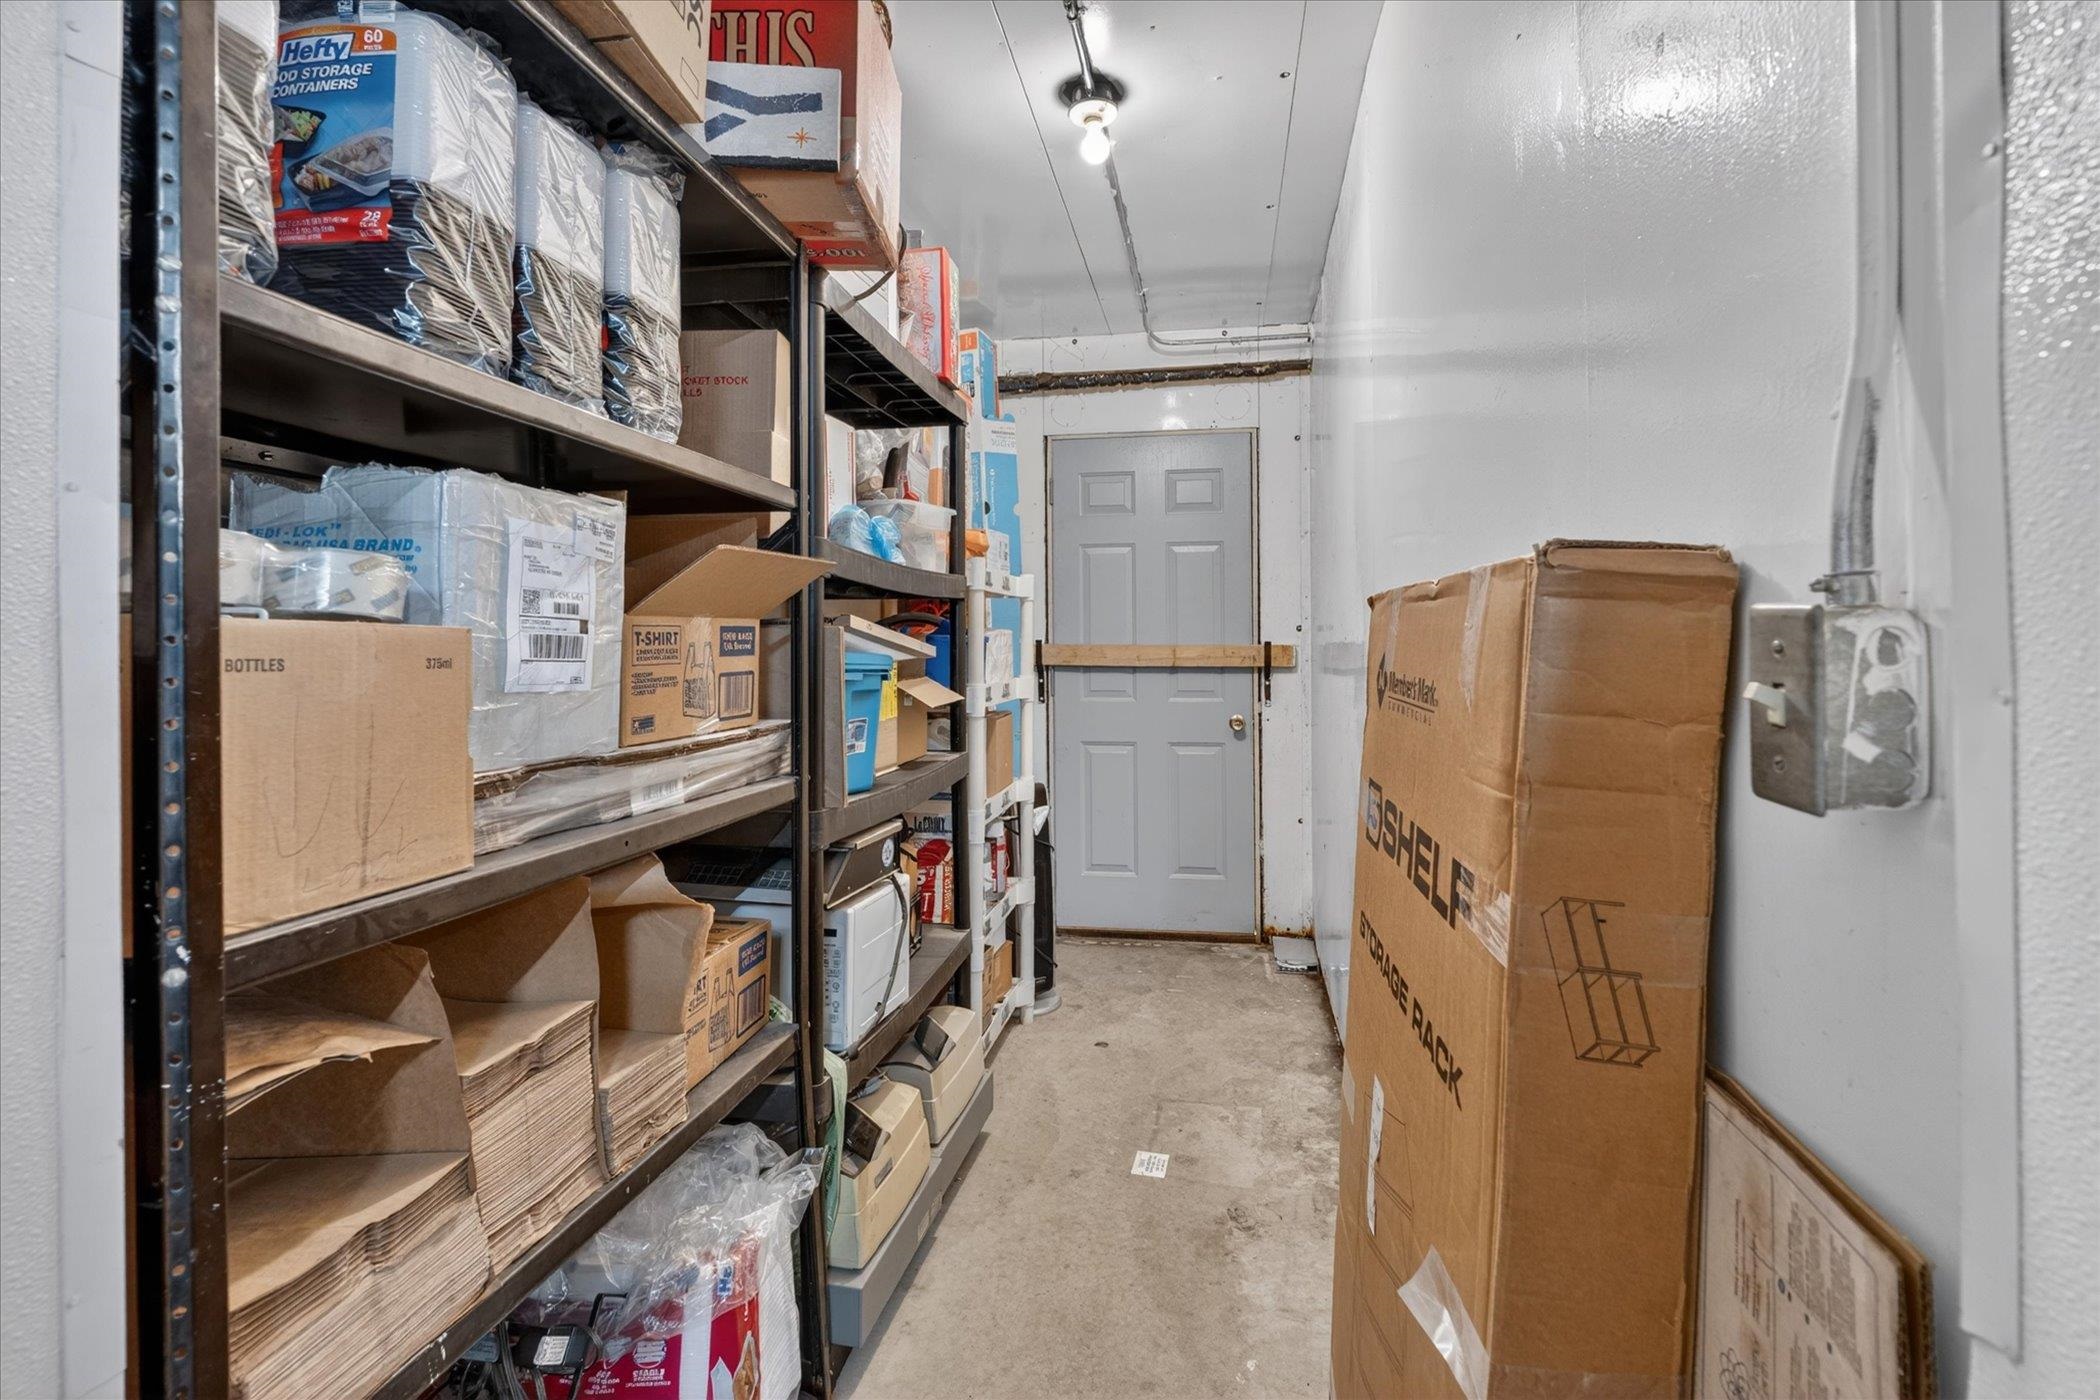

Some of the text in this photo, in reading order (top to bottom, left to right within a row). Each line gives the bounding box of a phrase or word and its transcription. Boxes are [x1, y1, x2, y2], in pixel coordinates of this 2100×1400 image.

[364, 29, 383, 43] 60
[283, 38, 350, 62] Hefty
[301, 63, 373, 80] STORAGE
[273, 78, 358, 98] CONTAINERS
[713, 376, 748, 385] STOCK
[634, 631, 678, 646] T-SHIRT
[225, 657, 453, 673] BOTTLES 375ml
[1360, 910, 1464, 1112] STORAGE RACK
